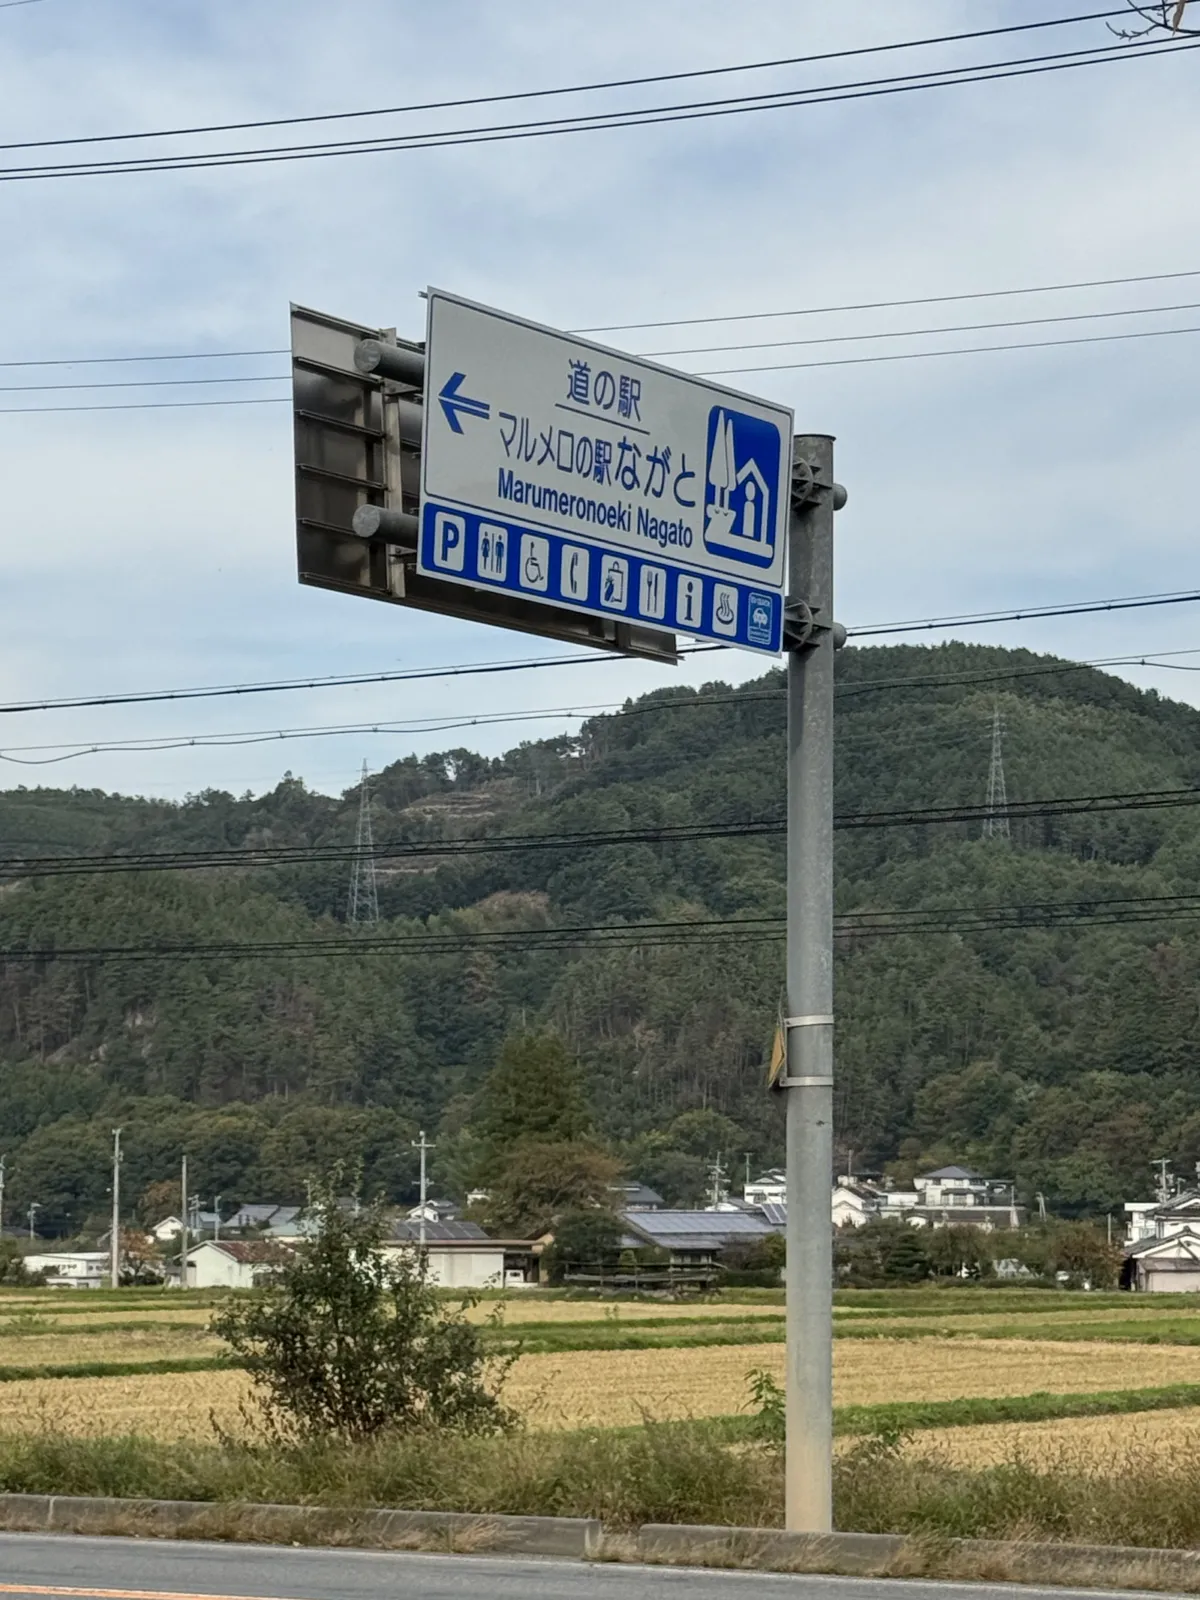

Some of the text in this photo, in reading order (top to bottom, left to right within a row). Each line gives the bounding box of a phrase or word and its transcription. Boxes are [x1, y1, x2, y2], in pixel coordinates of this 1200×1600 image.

[566, 358, 642, 422] 道の駅
[498, 411, 697, 508] マルメロの駅ながと
[442, 520, 461, 563] P
[498, 467, 694, 549] Marumeronoeki Nagato
